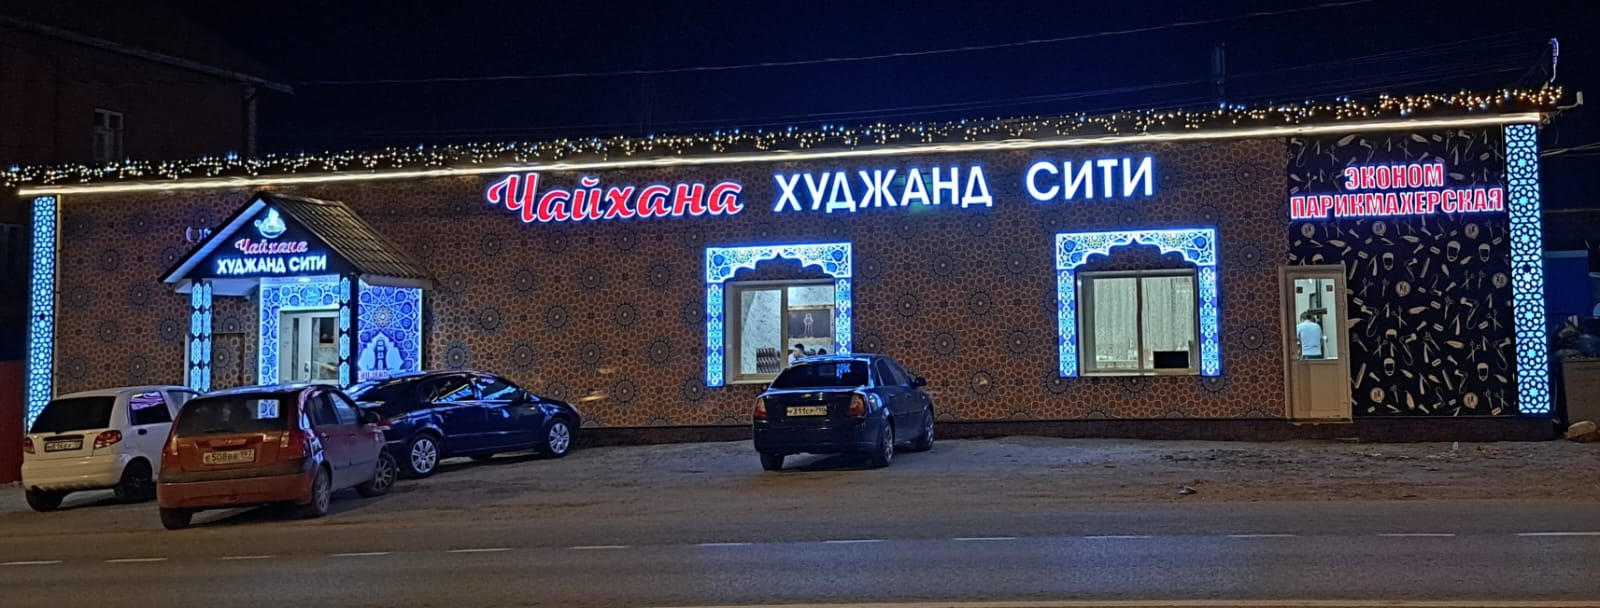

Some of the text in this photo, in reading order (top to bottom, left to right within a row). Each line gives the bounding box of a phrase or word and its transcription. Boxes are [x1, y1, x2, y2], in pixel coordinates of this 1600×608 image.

[487, 156, 1154, 223] Чайхана ХУДЖАНД СИТИ
[1344, 163, 1444, 190] ЭКОНОМ
[1290, 188, 1504, 219] ПАРИКМАХЕРСКАЯ
[234, 238, 308, 255] Чайхана
[216, 254, 327, 275] ХУДЖАНД СИТИ
